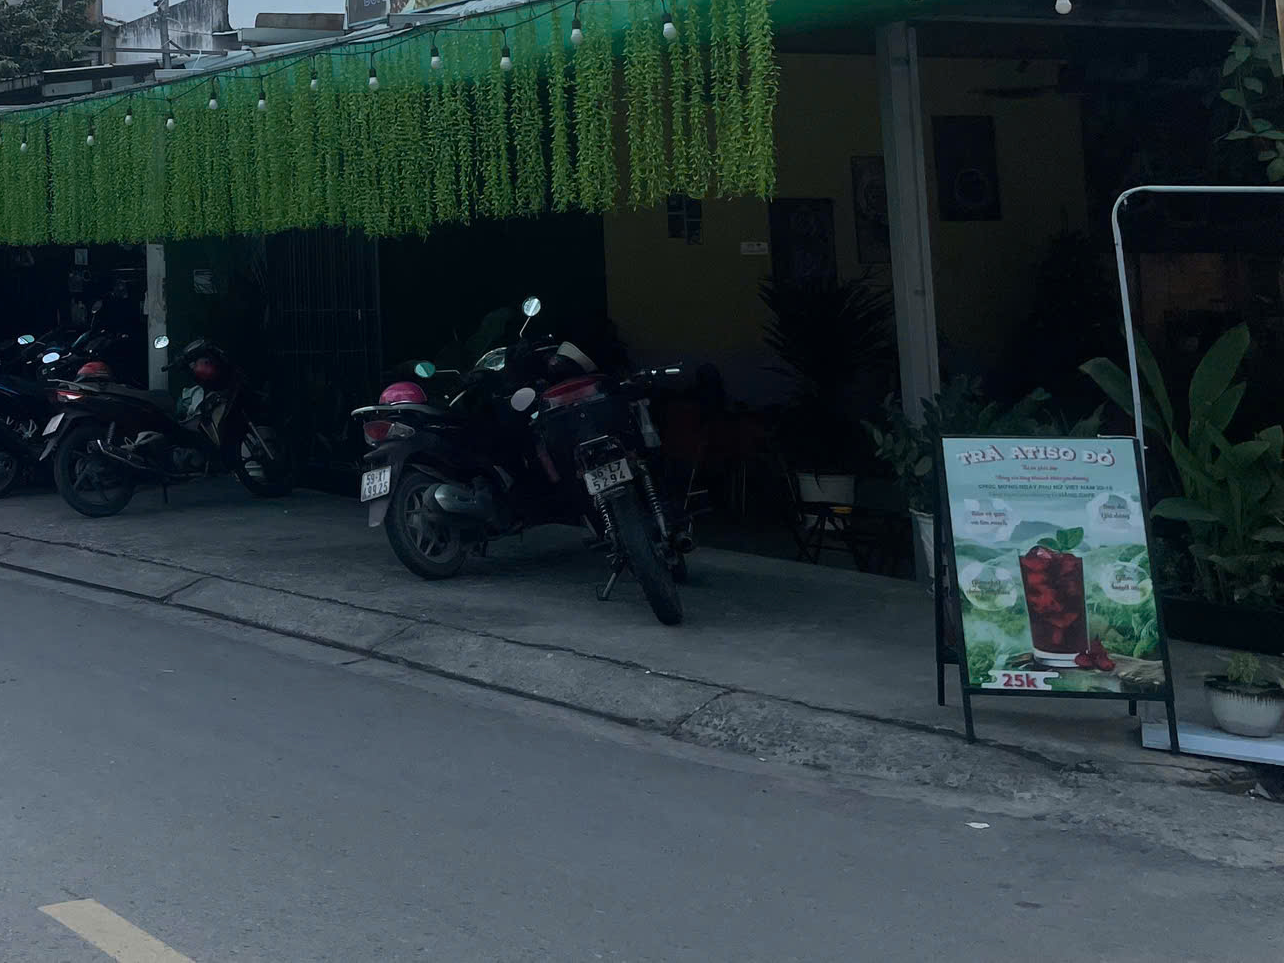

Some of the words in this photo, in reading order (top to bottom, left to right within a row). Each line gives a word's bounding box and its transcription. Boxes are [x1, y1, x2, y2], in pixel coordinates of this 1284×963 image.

[956, 445, 1004, 466] TRÀ
[1012, 445, 1077, 462] ATISO
[1002, 673, 1038, 688] 25k
